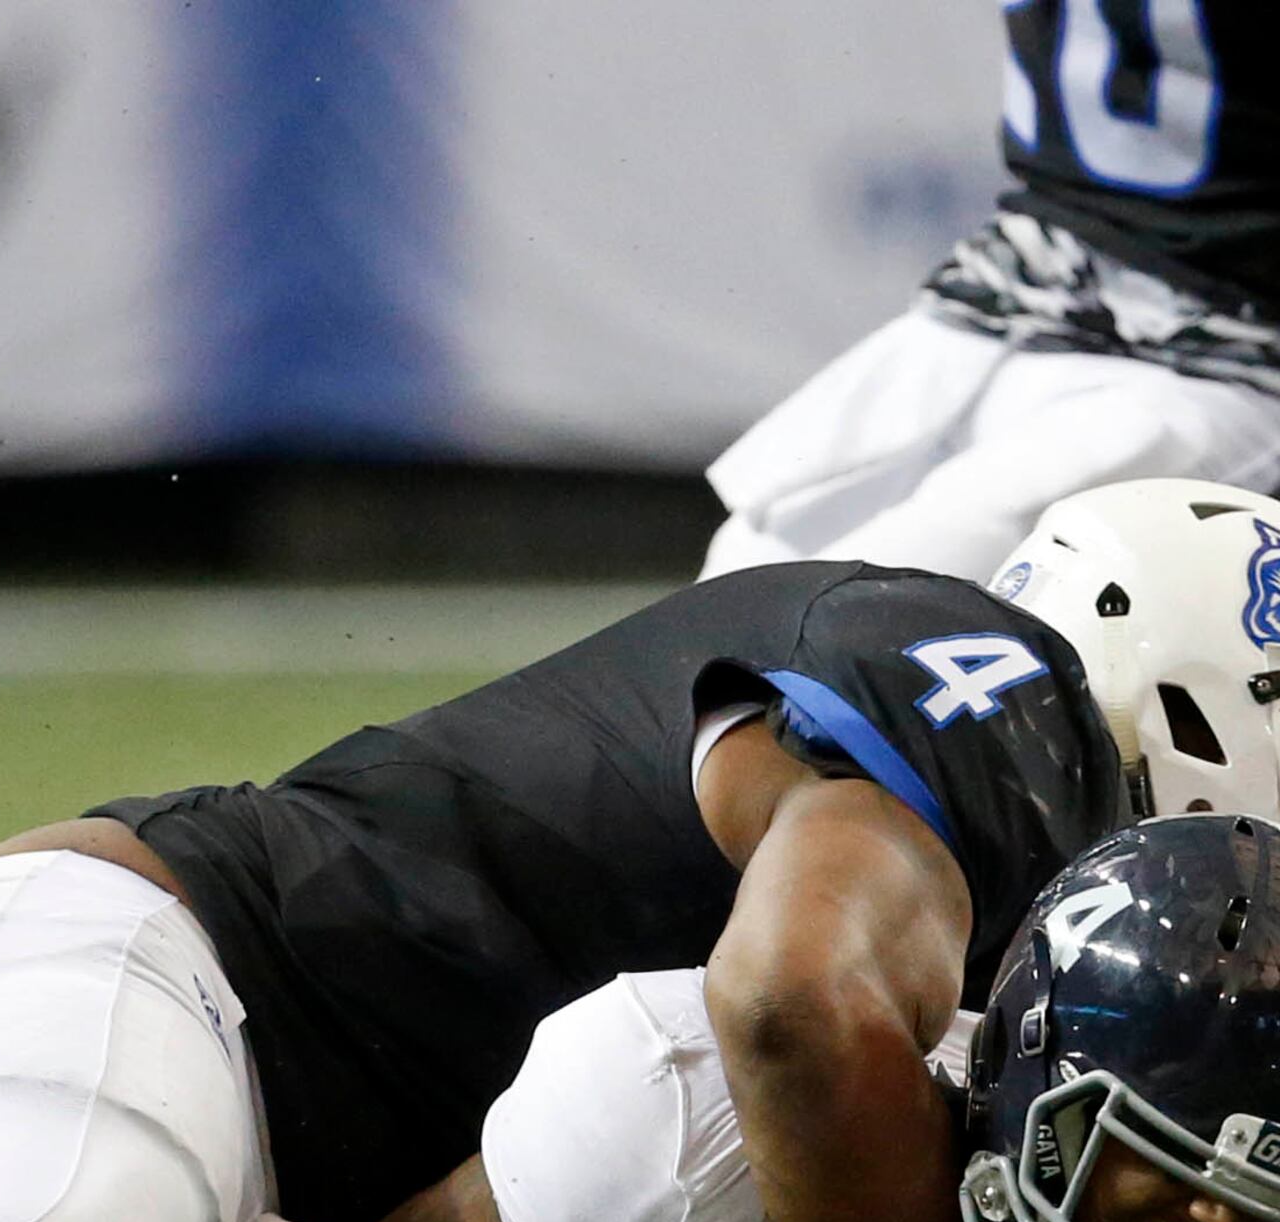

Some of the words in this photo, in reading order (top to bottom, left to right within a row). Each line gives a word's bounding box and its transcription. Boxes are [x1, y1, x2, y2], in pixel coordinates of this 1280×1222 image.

[903, 632, 1048, 729] 4
[1047, 882, 1133, 974] 4
[1036, 1125, 1062, 1179] GATA
